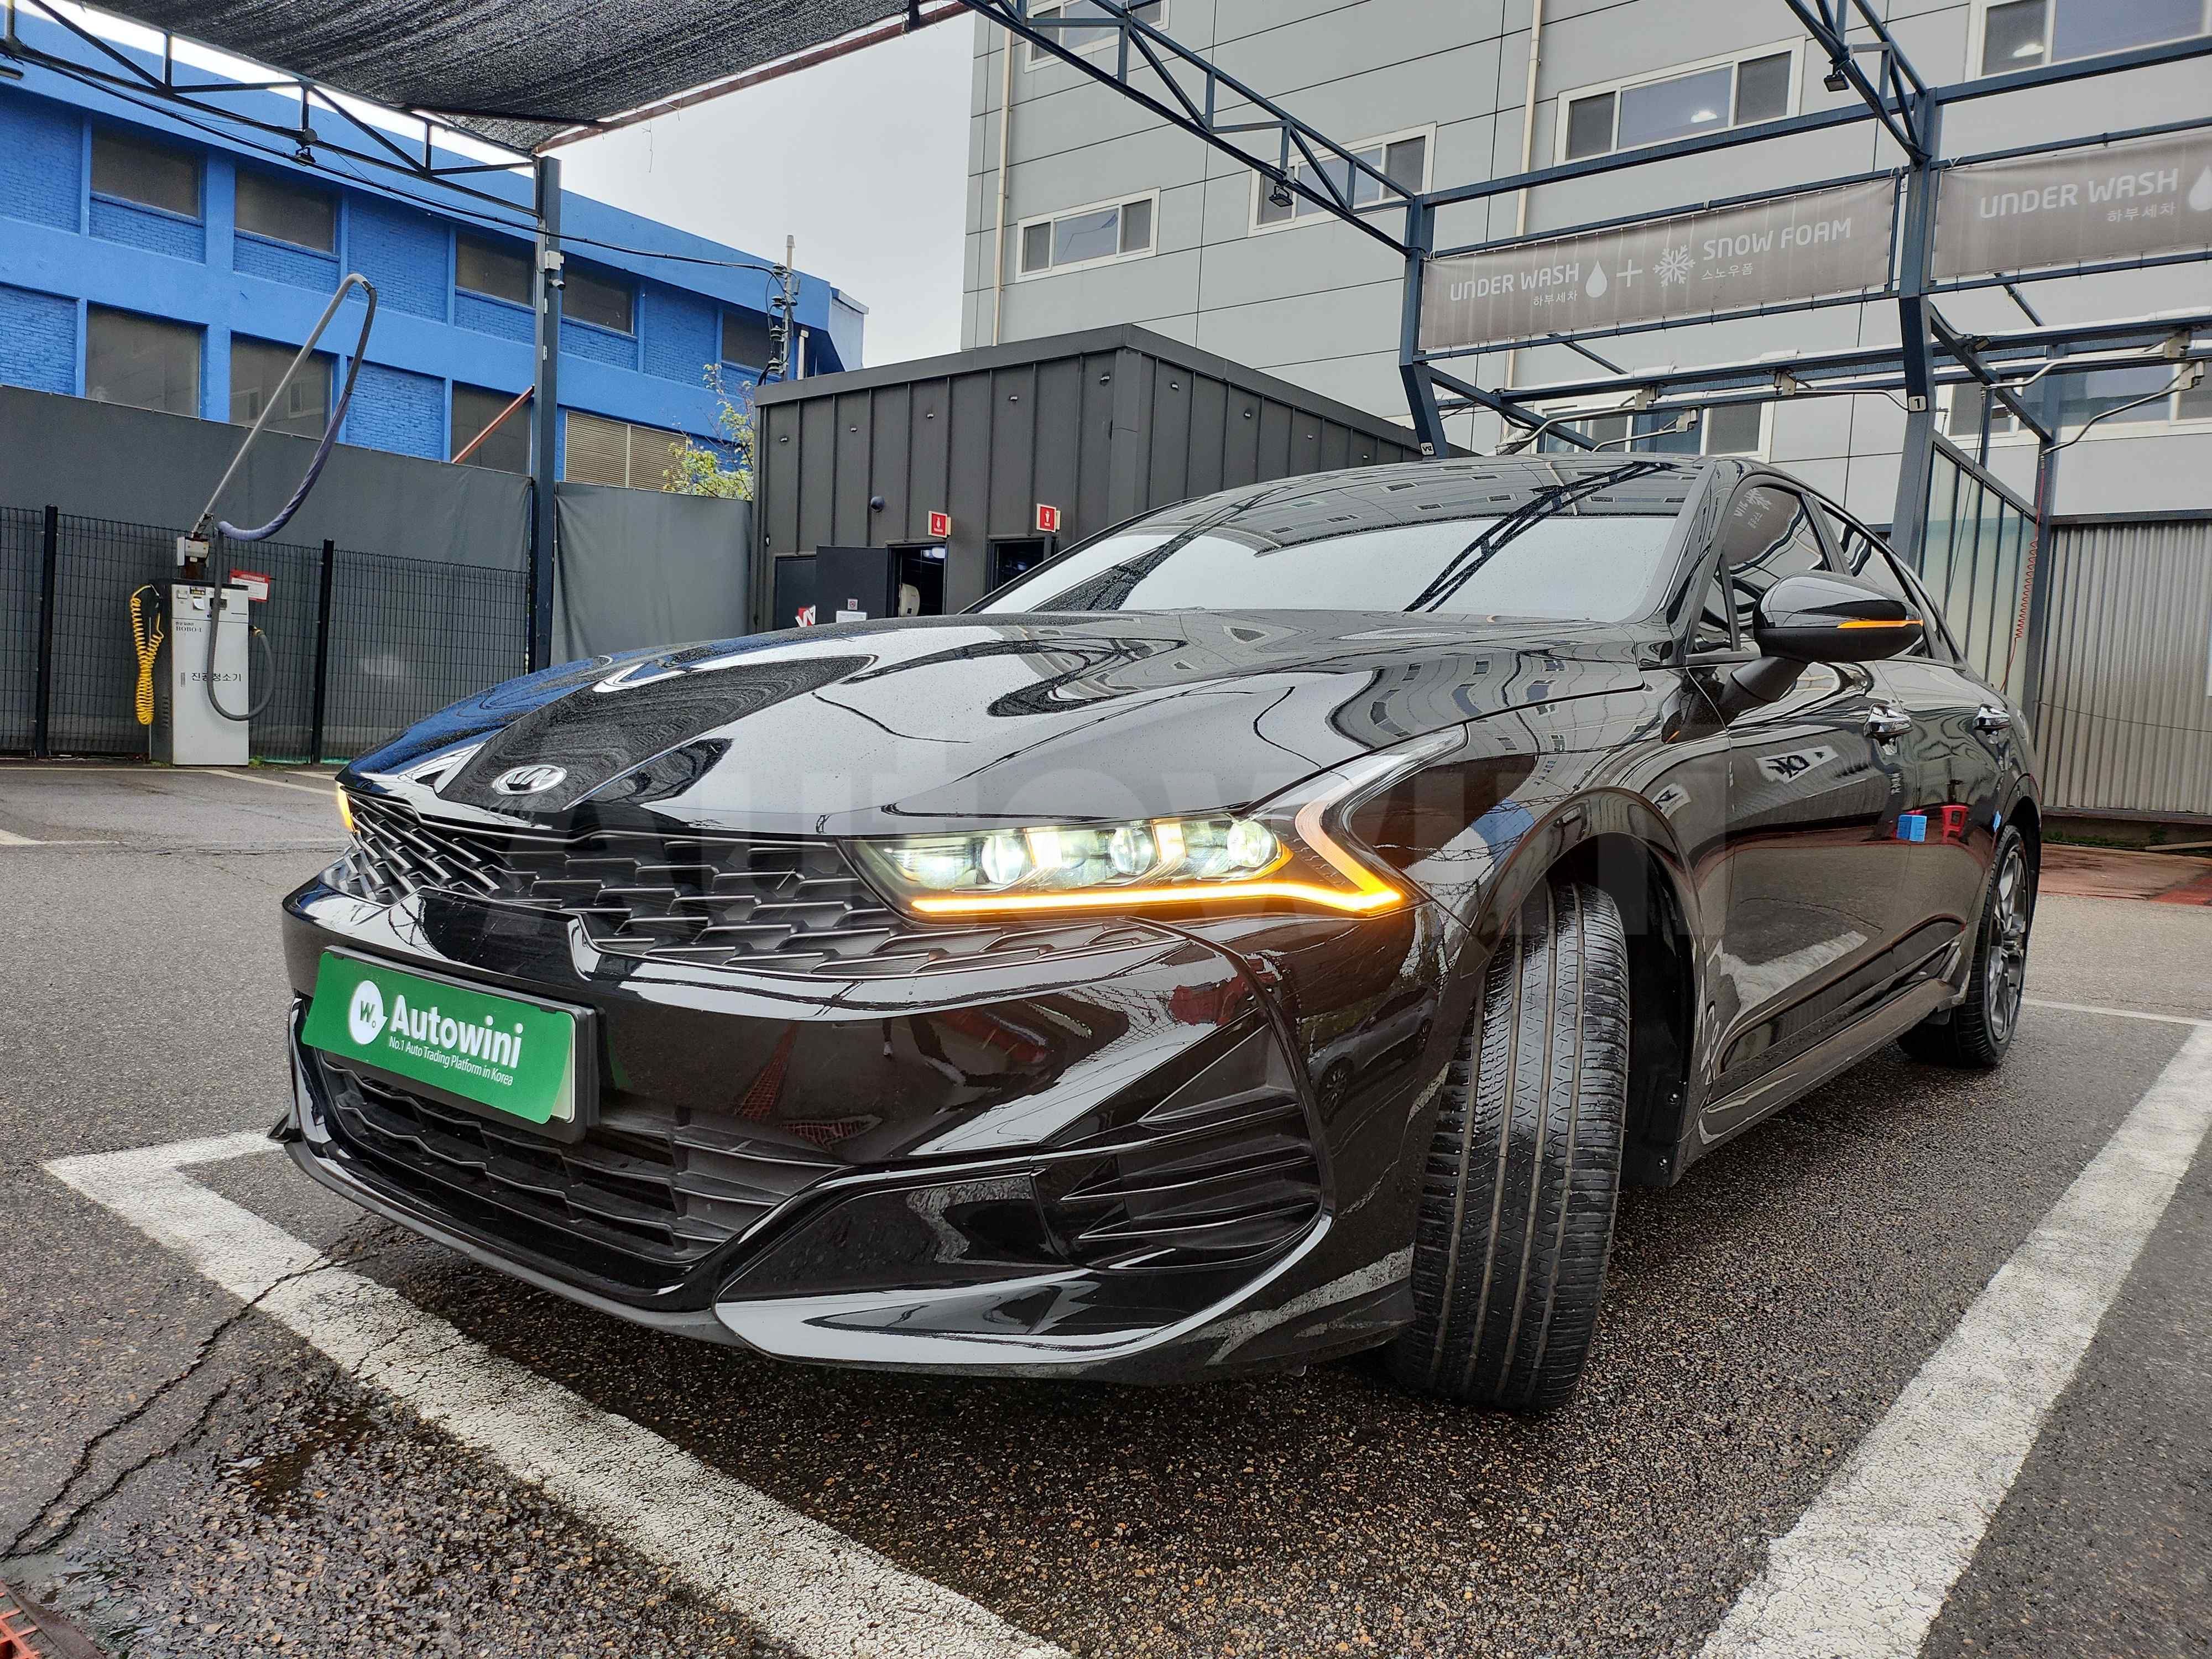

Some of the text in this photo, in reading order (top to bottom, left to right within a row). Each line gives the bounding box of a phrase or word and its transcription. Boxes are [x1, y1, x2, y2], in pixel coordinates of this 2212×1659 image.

[1979, 168, 2179, 218] UNDER WASH
[2106, 201, 2176, 222] 하부세차
[1450, 274, 1514, 301] UNDER
[1520, 263, 1579, 290] WASH
[1703, 229, 1774, 260] SNOW
[1781, 217, 1851, 248] FOAM
[1701, 263, 1754, 280] 스노우폼
[1533, 290, 1577, 307] 하부세차
[389, 994, 524, 1068] Autowini
[389, 1036, 514, 1086] No.1 Auto Trading Platform in Korea
